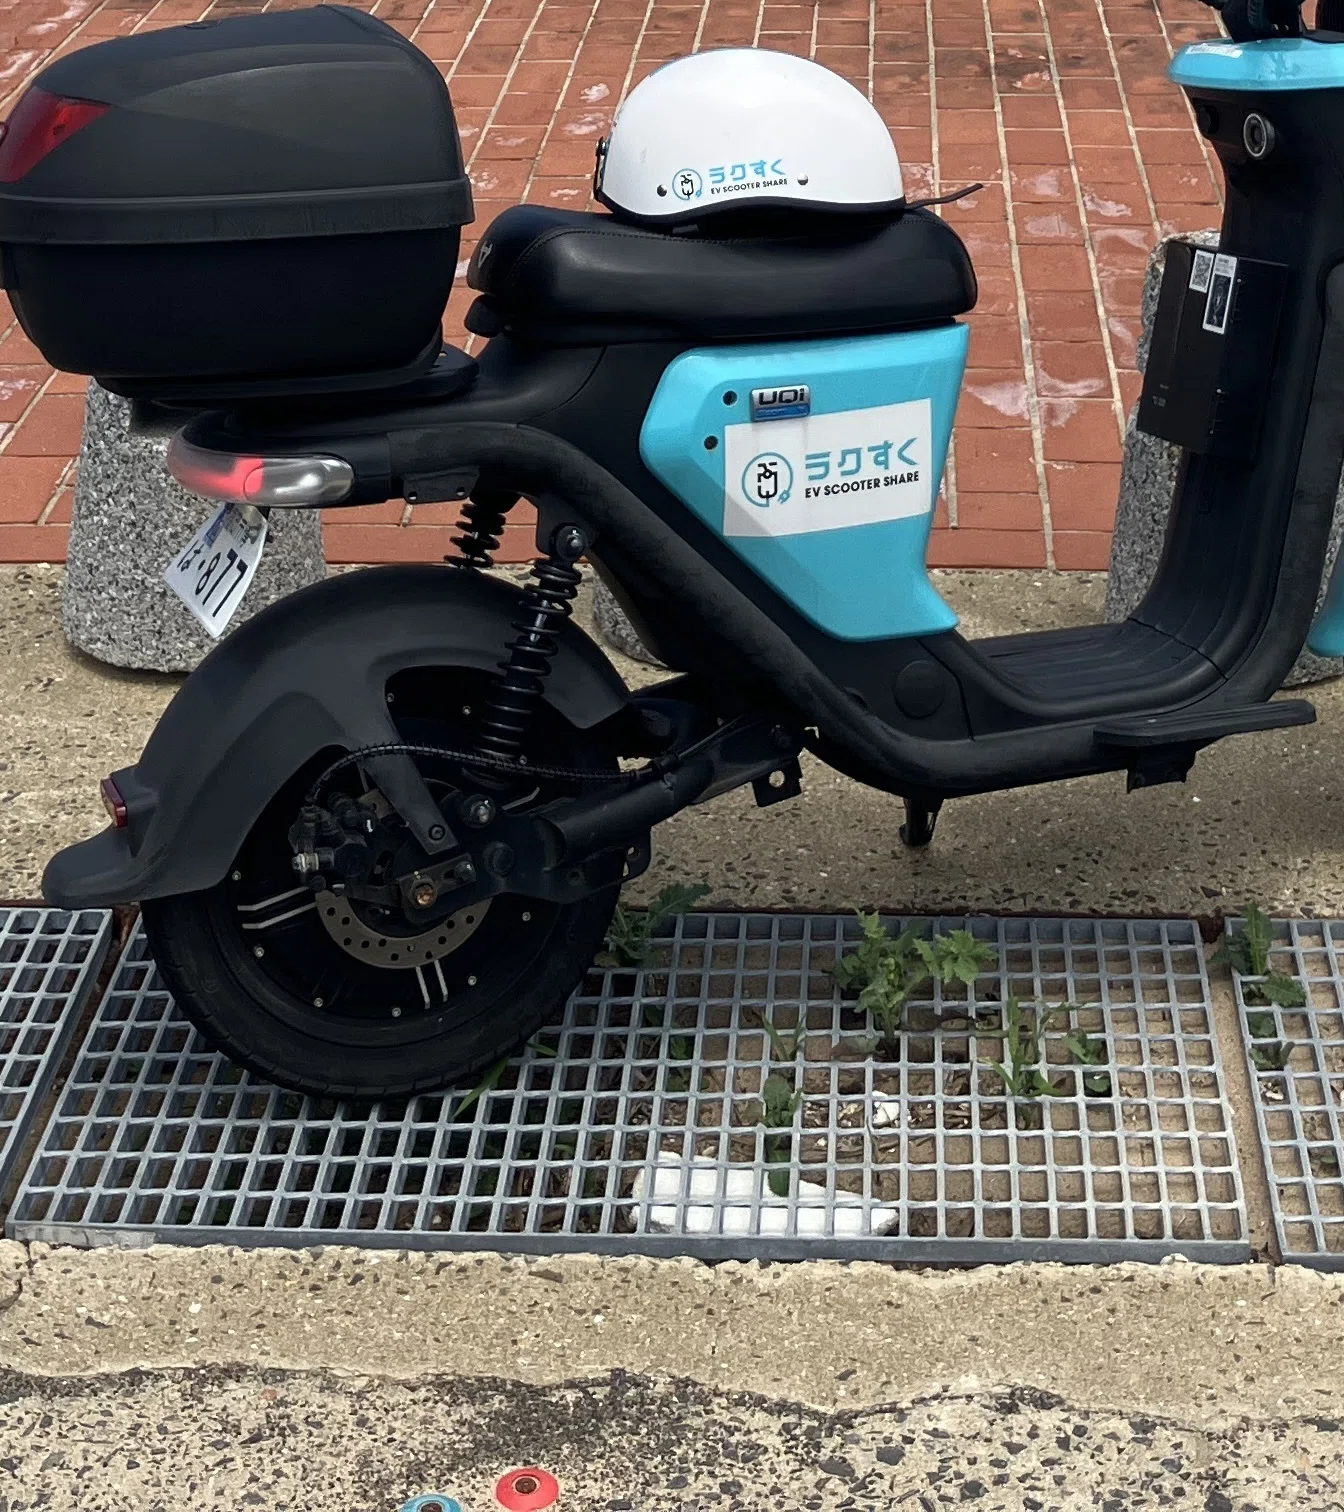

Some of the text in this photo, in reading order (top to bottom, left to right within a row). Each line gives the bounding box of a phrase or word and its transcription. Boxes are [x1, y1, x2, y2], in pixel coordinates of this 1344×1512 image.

[709, 158, 786, 184] ラクすく
[723, 182, 761, 192] SCOOTER
[762, 178, 788, 187] SHARE
[805, 437, 918, 481] ラクすく
[805, 471, 919, 498] EV SCOOTER SHARE
